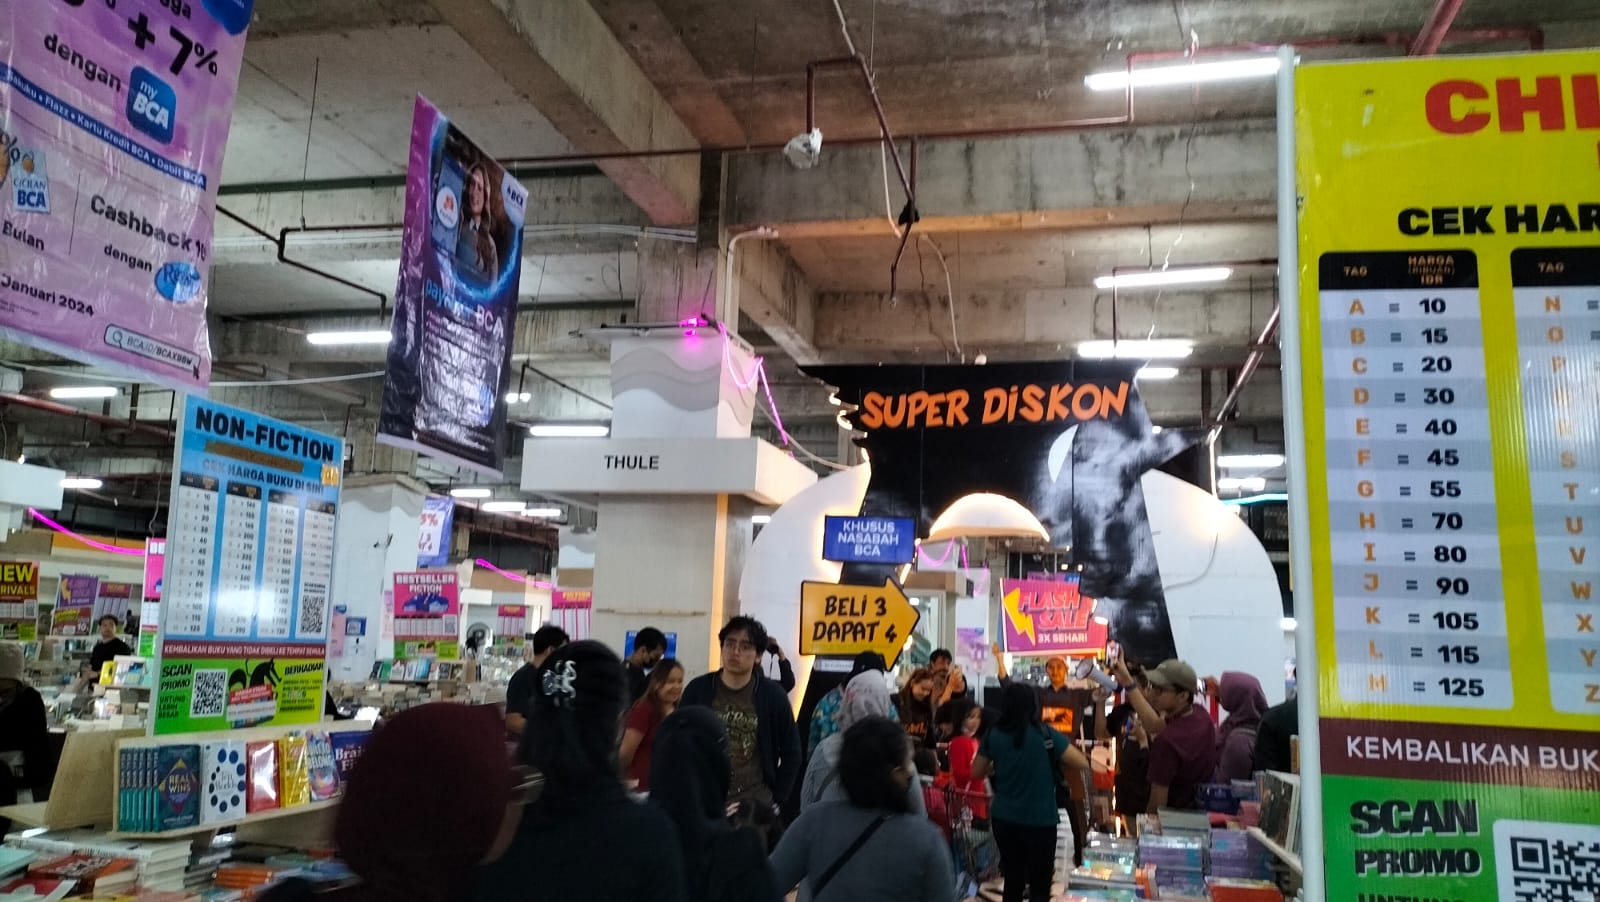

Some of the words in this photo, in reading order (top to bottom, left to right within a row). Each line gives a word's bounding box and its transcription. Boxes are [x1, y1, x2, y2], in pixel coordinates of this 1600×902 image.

[169, 26, 218, 76] 7%
[44, 34, 121, 92] dengan
[140, 80, 158, 97] my
[133, 95, 169, 129] BCA
[77, 113, 102, 136] Kartu
[103, 128, 130, 150] Kredit
[132, 142, 150, 161] BCA
[157, 157, 182, 176] Debit
[17, 190, 46, 208] BCA
[90, 194, 193, 250] Cashback
[1398, 205, 1495, 236] CEK
[1504, 203, 1600, 234] HAR
[103, 244, 153, 272] dengan
[1408, 255, 1454, 266] HARGA
[1344, 267, 1368, 277] TAG
[1538, 262, 1564, 273] TAG
[1420, 274, 1443, 285] IDR
[1, 273, 56, 304] Januari
[58, 295, 95, 317] 2024
[1349, 299, 1364, 315] A
[1419, 298, 1446, 314] 10
[1350, 328, 1365, 344] B
[1421, 328, 1448, 344] 15
[1352, 357, 1367, 375] C
[1421, 356, 1452, 373] 20
[1354, 388, 1369, 404] D
[1423, 388, 1454, 404] 30
[860, 388, 970, 430] SUPER
[195, 406, 335, 461] NON-FICTION
[1356, 419, 1370, 435] E
[1425, 419, 1457, 435] 40
[604, 455, 660, 470] THULE
[1358, 449, 1371, 466] F
[1427, 449, 1459, 466] 45
[227, 464, 265, 483] HARGA
[266, 473, 294, 488] BUKU
[1358, 481, 1374, 497] G
[1430, 481, 1461, 497] 55
[843, 520, 896, 533] KHUSUS
[1359, 512, 1376, 529] H
[1432, 512, 1463, 530] 70
[837, 532, 899, 545] NASABAH
[854, 544, 881, 557] BCA
[1364, 543, 1376, 561] I
[1434, 546, 1467, 563] 80
[396, 574, 455, 584] BESTSELLER
[1364, 573, 1379, 591] J
[1436, 577, 1469, 595] 90
[409, 584, 442, 593] FICTION
[875, 597, 887, 617] 3
[1018, 590, 1081, 612] FLASH
[1039, 610, 1091, 632] SALE
[1366, 607, 1381, 624] K
[1433, 612, 1479, 630] 105
[812, 621, 880, 642] DAPAT
[885, 624, 898, 643] 4
[1052, 633, 1088, 643] SEHARI
[164, 644, 208, 654] KEMBALIKAN
[207, 645, 225, 654] BUKU
[1369, 640, 1383, 659] L
[1437, 645, 1480, 664] 115
[162, 663, 192, 677] SCAN
[161, 679, 190, 690] PROMO
[1369, 674, 1387, 691] M
[1438, 678, 1484, 697] 125
[1346, 735, 1529, 767] KEMBALIKAN
[1539, 746, 1600, 772] BUK
[168, 783, 191, 793] WINS
[169, 774, 190, 784] REAL
[1350, 798, 1480, 836] SCAN
[1354, 847, 1482, 878] PROMO
